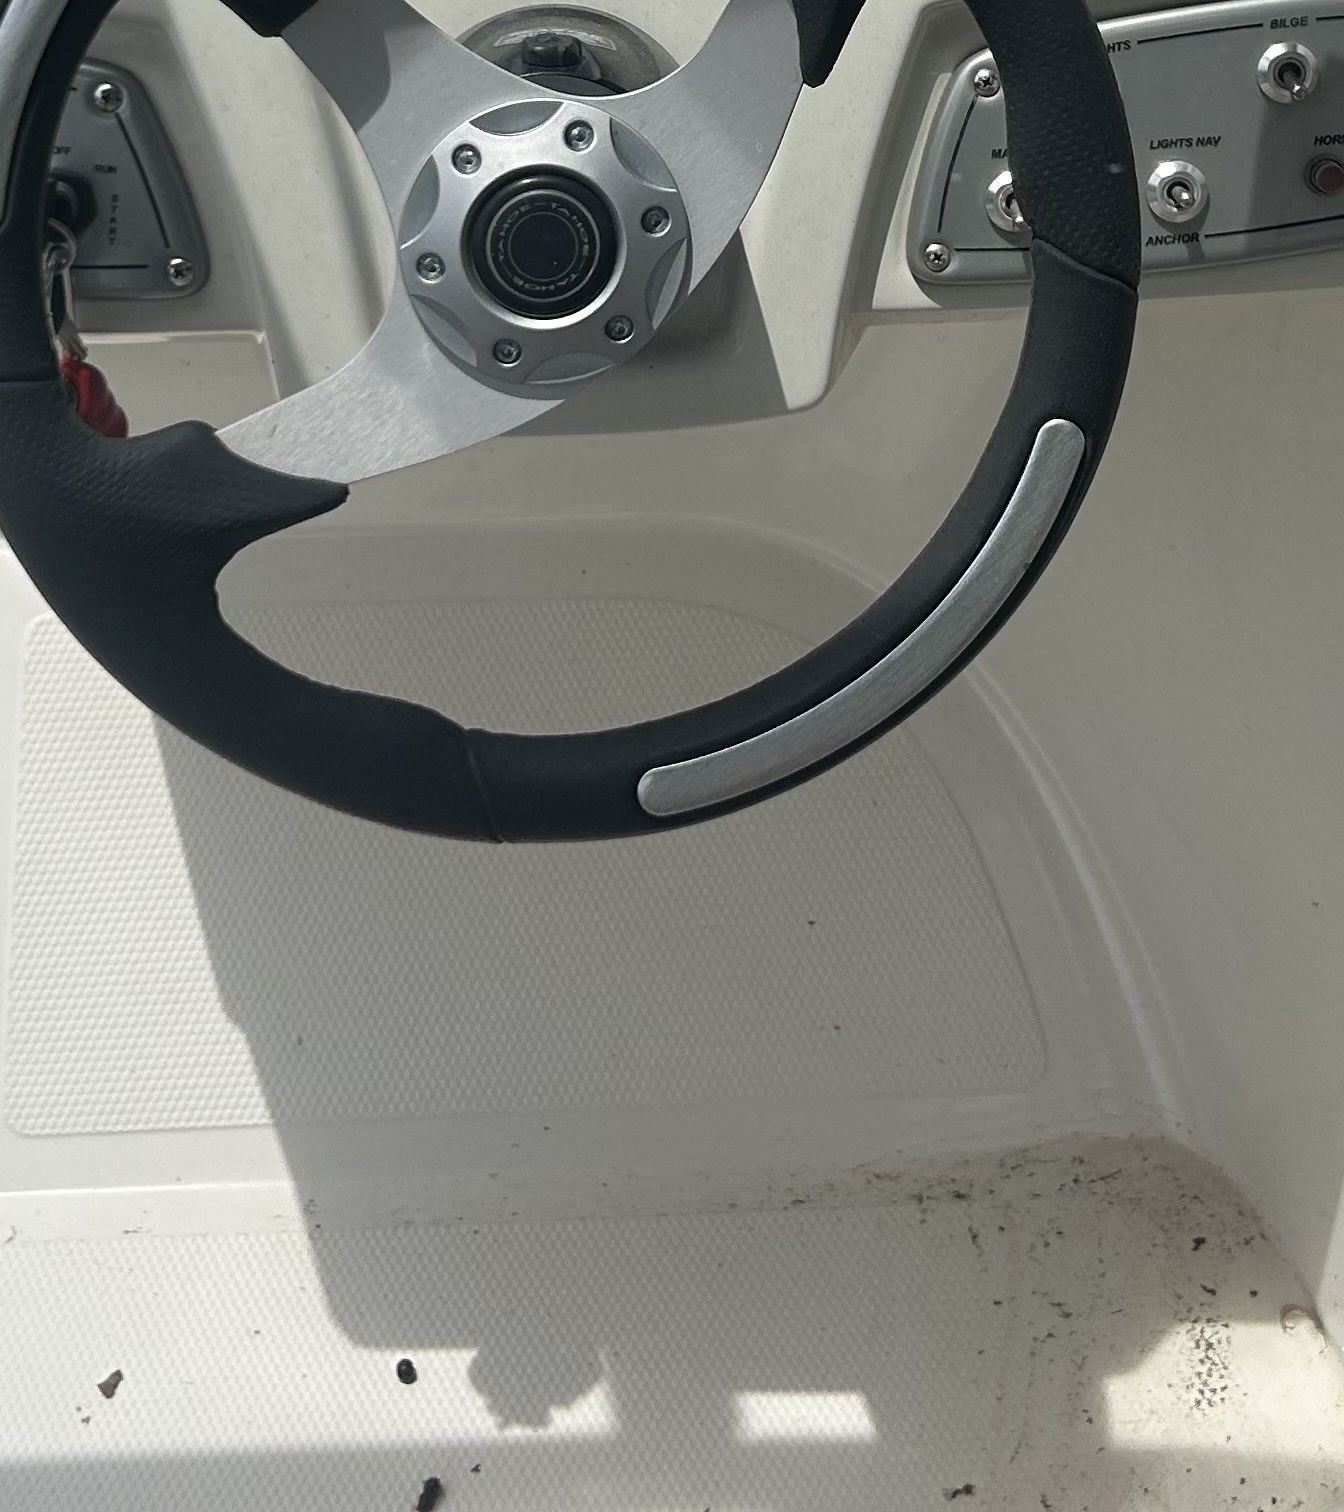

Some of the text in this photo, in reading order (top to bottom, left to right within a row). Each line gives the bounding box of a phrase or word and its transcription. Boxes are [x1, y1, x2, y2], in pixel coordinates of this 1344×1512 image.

[1270, 16, 1309, 30] BILGE
[1149, 135, 1222, 151] LIGHTS NAV
[94, 163, 118, 174] RUN
[1144, 232, 1200, 248] ANCHOR
